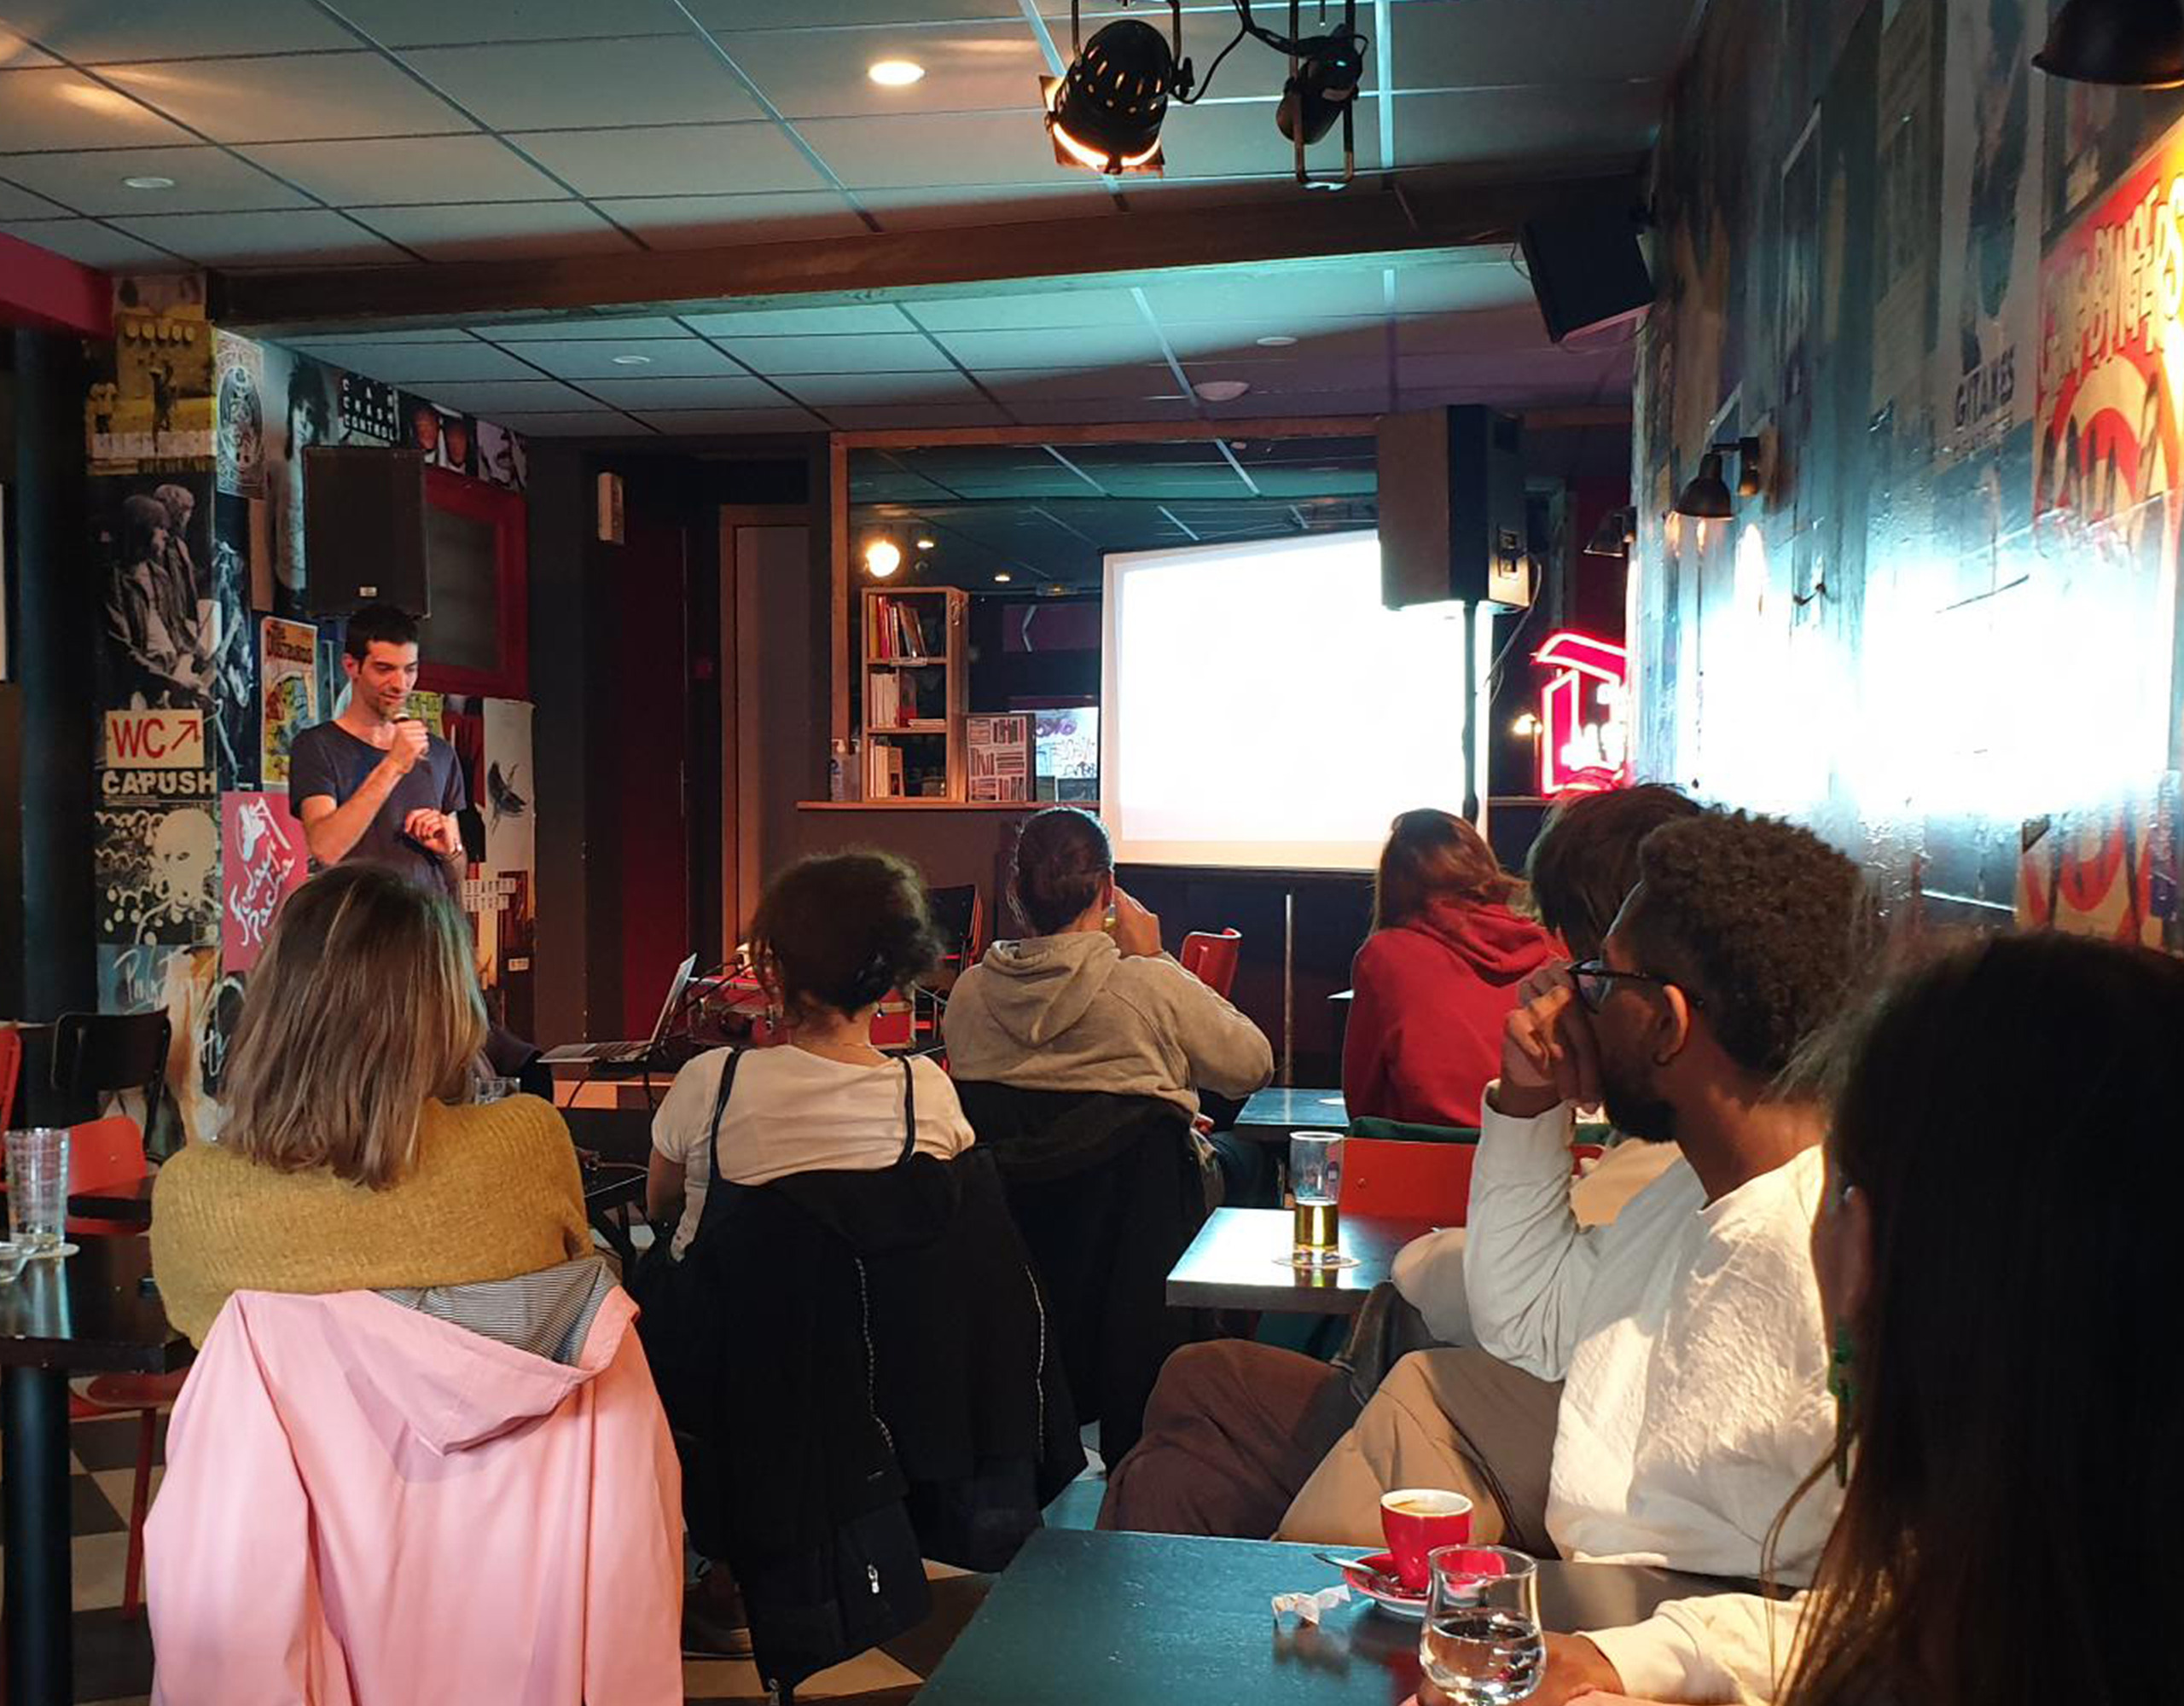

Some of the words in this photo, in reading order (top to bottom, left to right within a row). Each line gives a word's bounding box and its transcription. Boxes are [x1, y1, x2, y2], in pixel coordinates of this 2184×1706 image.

[344, 414, 394, 441] CONTROL
[112, 718, 166, 758] WC
[102, 770, 218, 795] CAPUSH
